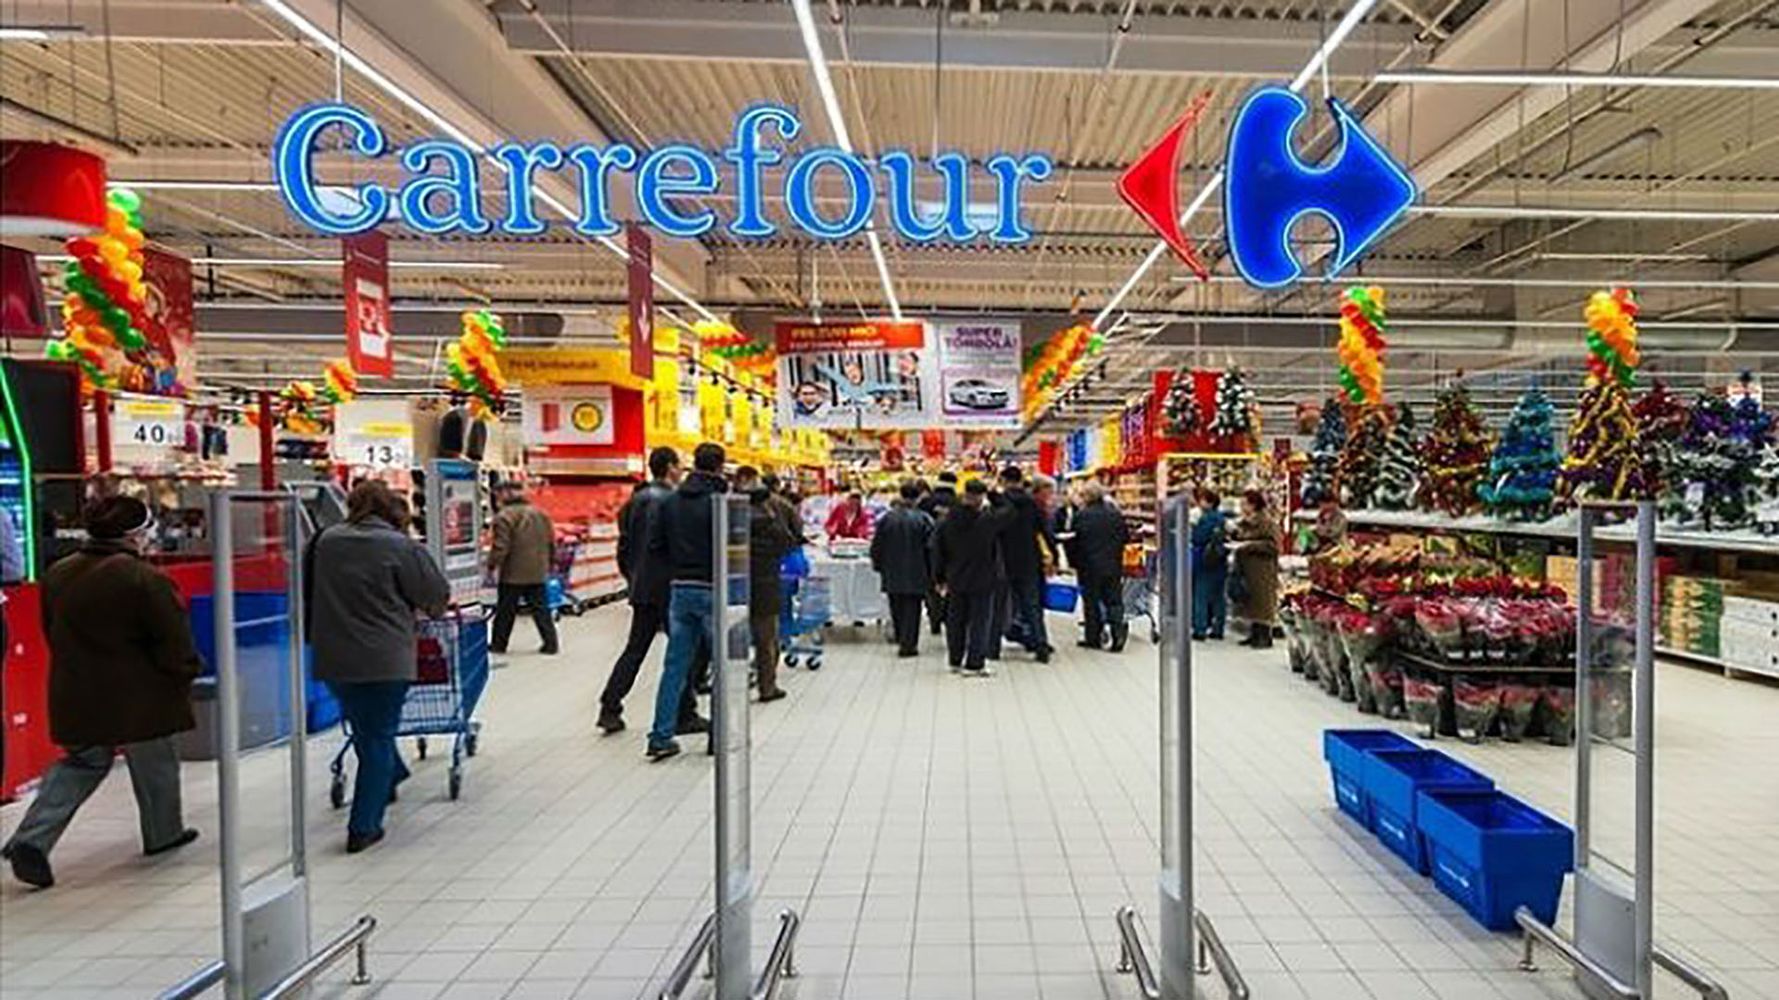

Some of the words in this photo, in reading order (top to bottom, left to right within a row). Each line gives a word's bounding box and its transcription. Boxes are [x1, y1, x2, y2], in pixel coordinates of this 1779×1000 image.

[274, 102, 1051, 244] Carrefour
[956, 326, 1003, 337] SUPER
[134, 424, 165, 443] 40
[366, 445, 394, 464] 13
